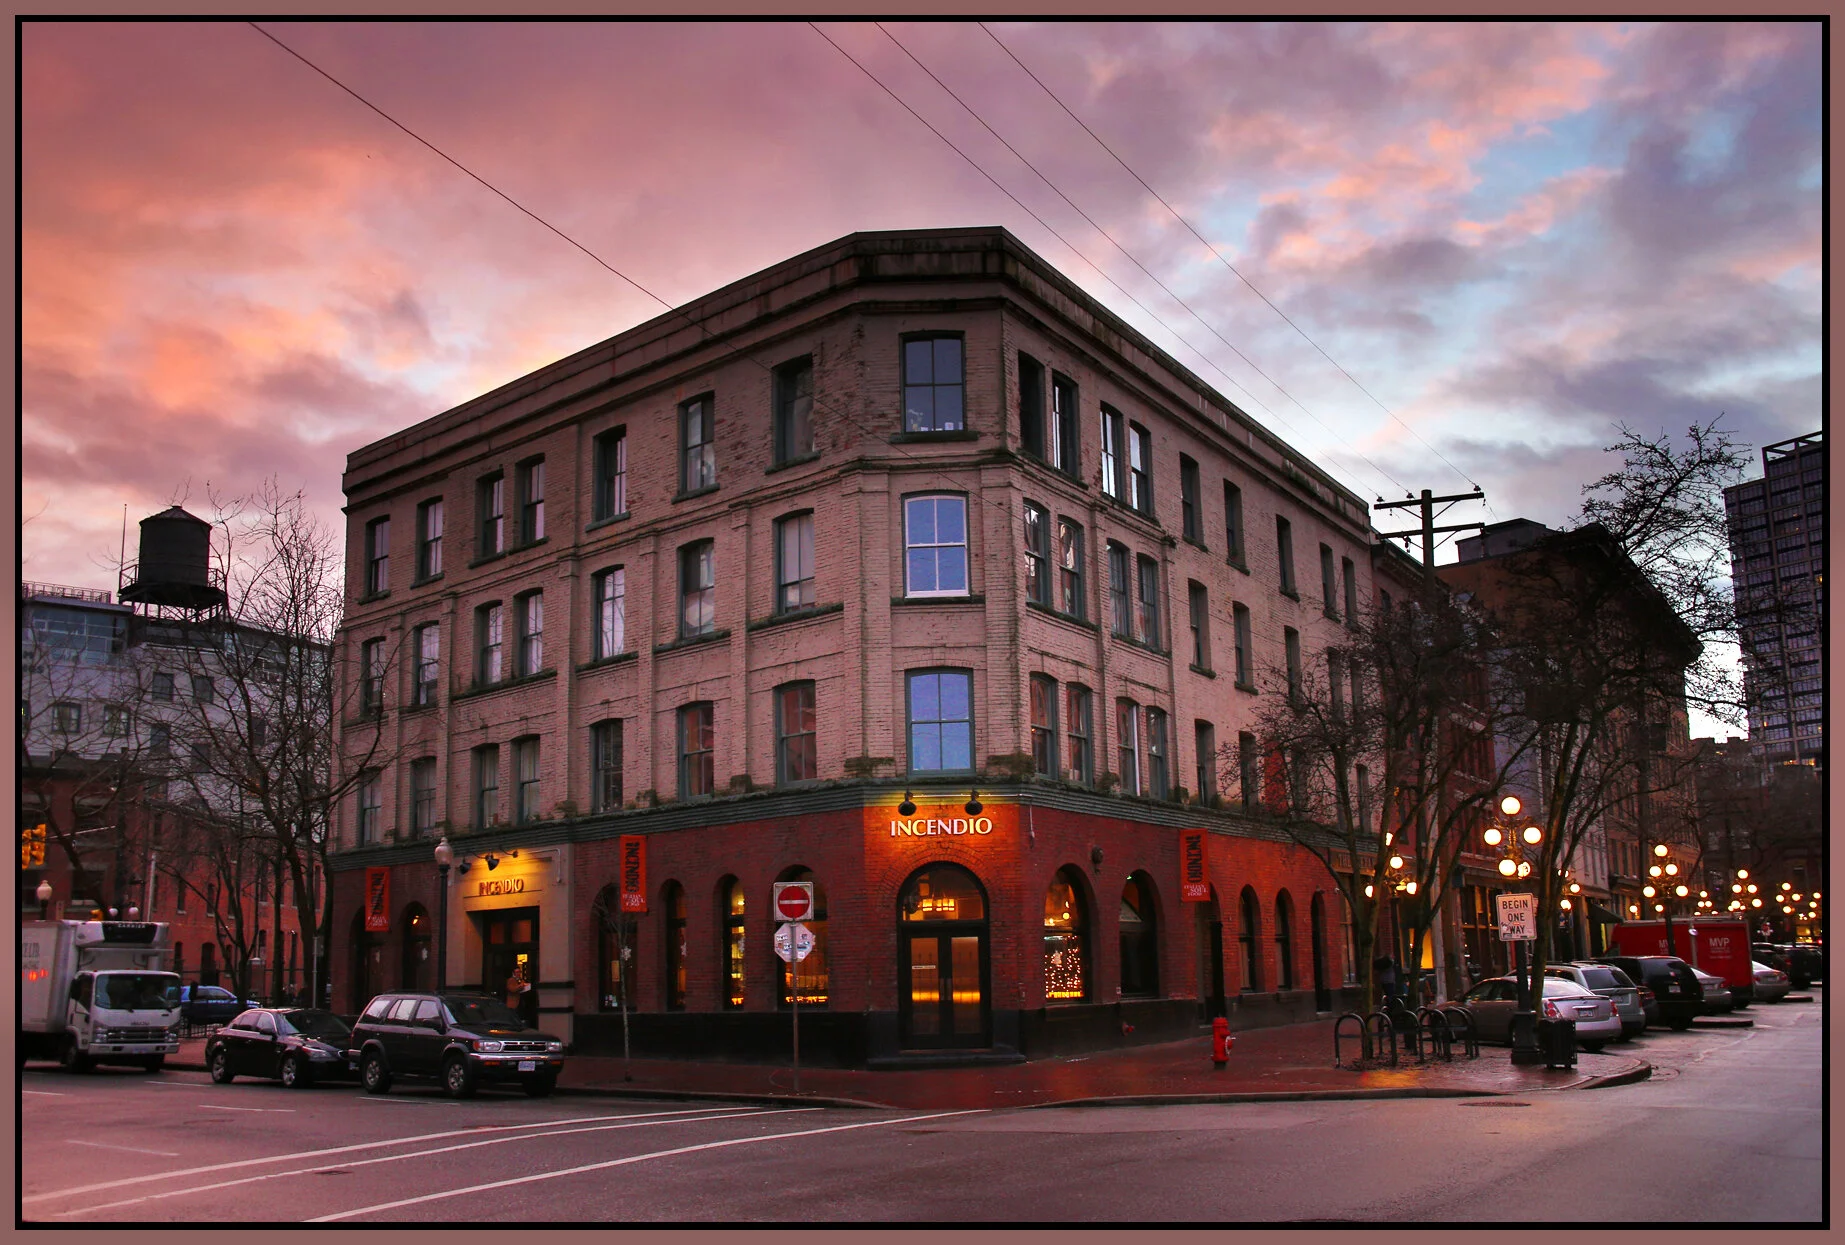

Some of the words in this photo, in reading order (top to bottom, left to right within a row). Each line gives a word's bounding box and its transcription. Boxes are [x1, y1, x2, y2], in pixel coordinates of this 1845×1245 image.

[890, 818, 993, 837] INCENDIO
[479, 879, 524, 896] INCENDIO
[1502, 900, 1528, 909] BEGIN
[1507, 913, 1525, 922] ONE
[1510, 925, 1525, 935] WAY
[1709, 937, 1730, 947] MVP
